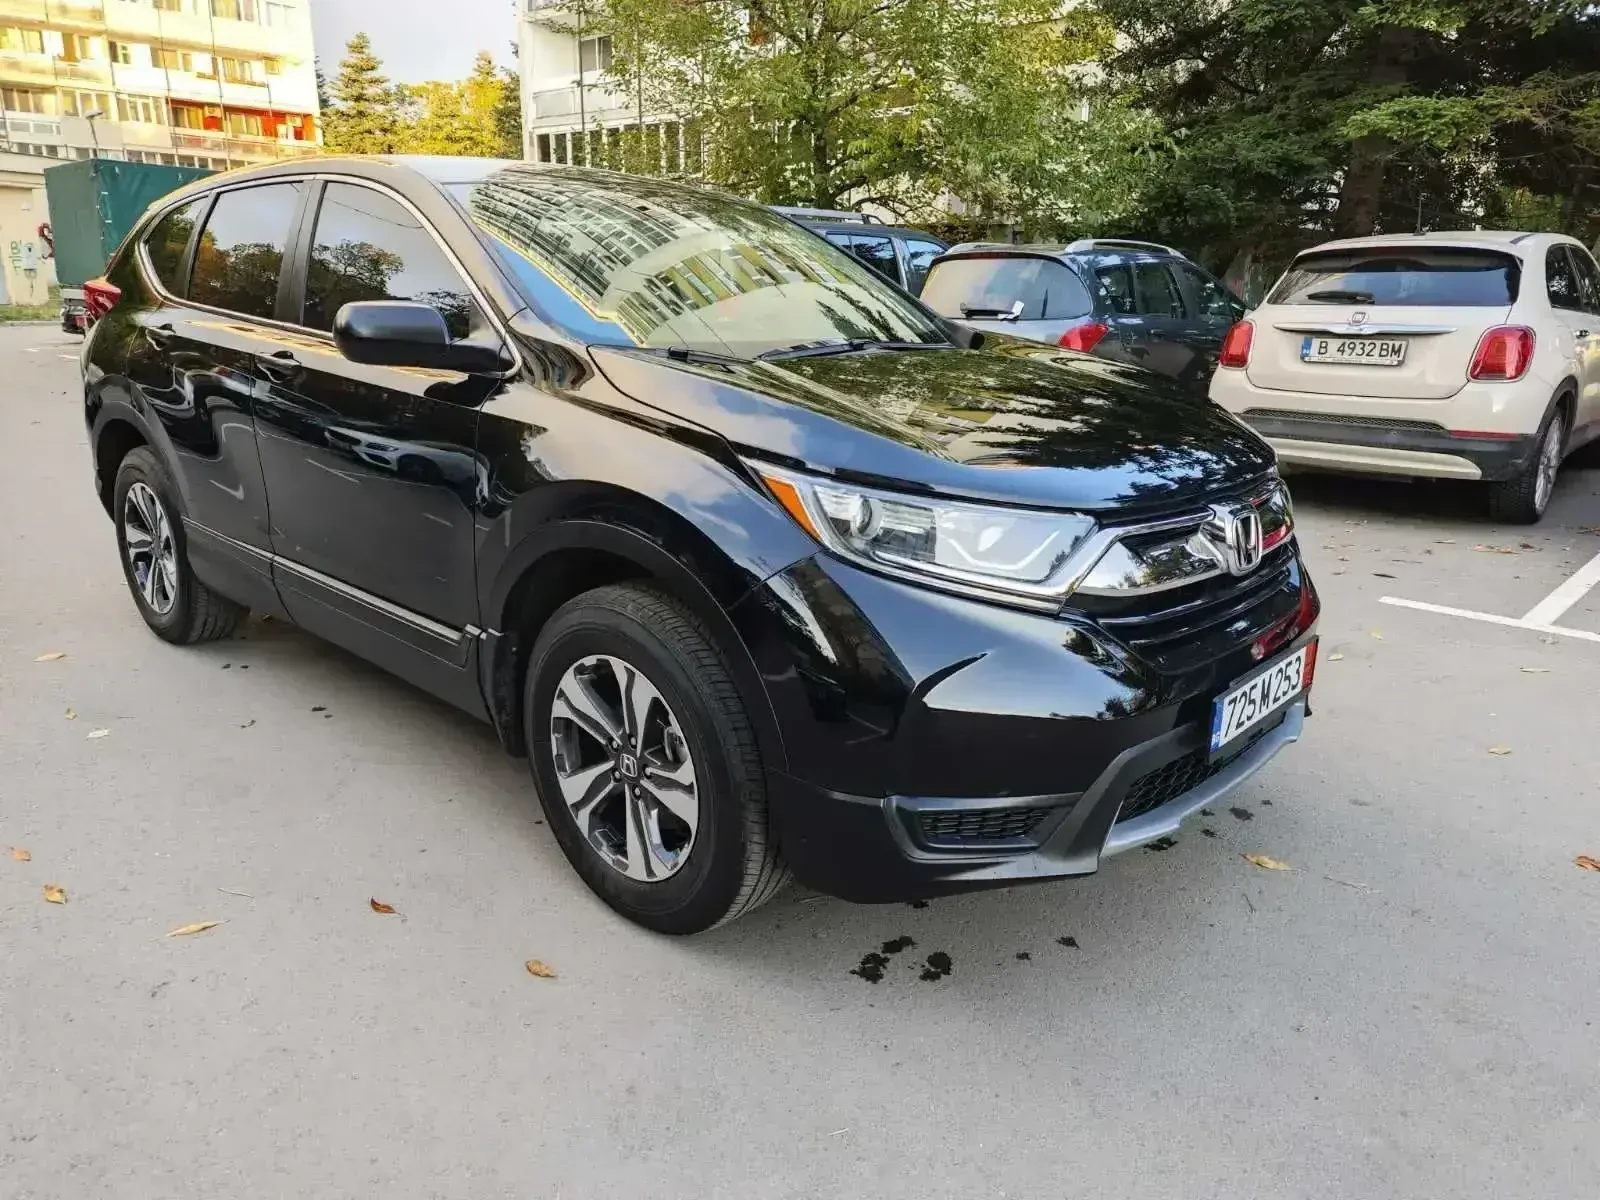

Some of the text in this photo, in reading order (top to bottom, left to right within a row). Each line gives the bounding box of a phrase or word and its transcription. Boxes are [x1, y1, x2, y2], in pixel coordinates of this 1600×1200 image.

[1318, 340, 1403, 358] B 4932 BM
[1224, 683, 1259, 738] 725
[1259, 673, 1272, 714] M
[1272, 655, 1302, 705] 253
